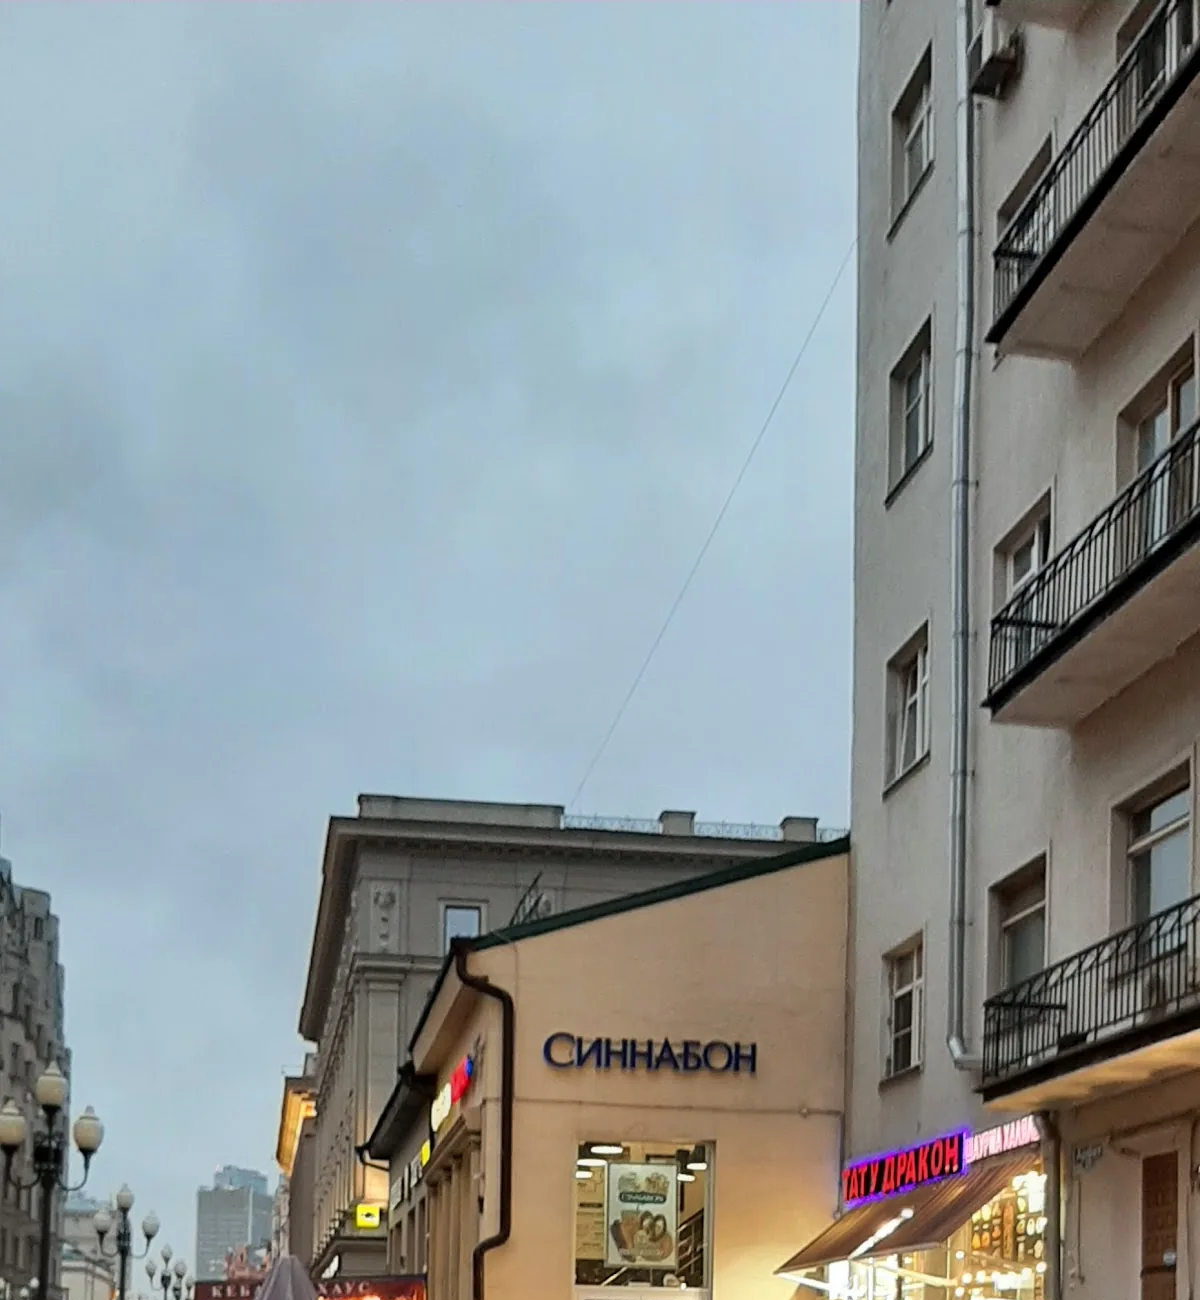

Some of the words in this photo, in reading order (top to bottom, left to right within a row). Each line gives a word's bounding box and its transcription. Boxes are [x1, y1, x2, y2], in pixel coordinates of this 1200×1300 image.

[543, 1031, 757, 1073] СИННАБОН
[842, 1159, 879, 1201] ТАТУ
[881, 1134, 959, 1196] ДРАКОН
[317, 1281, 370, 1295] ХАУС
